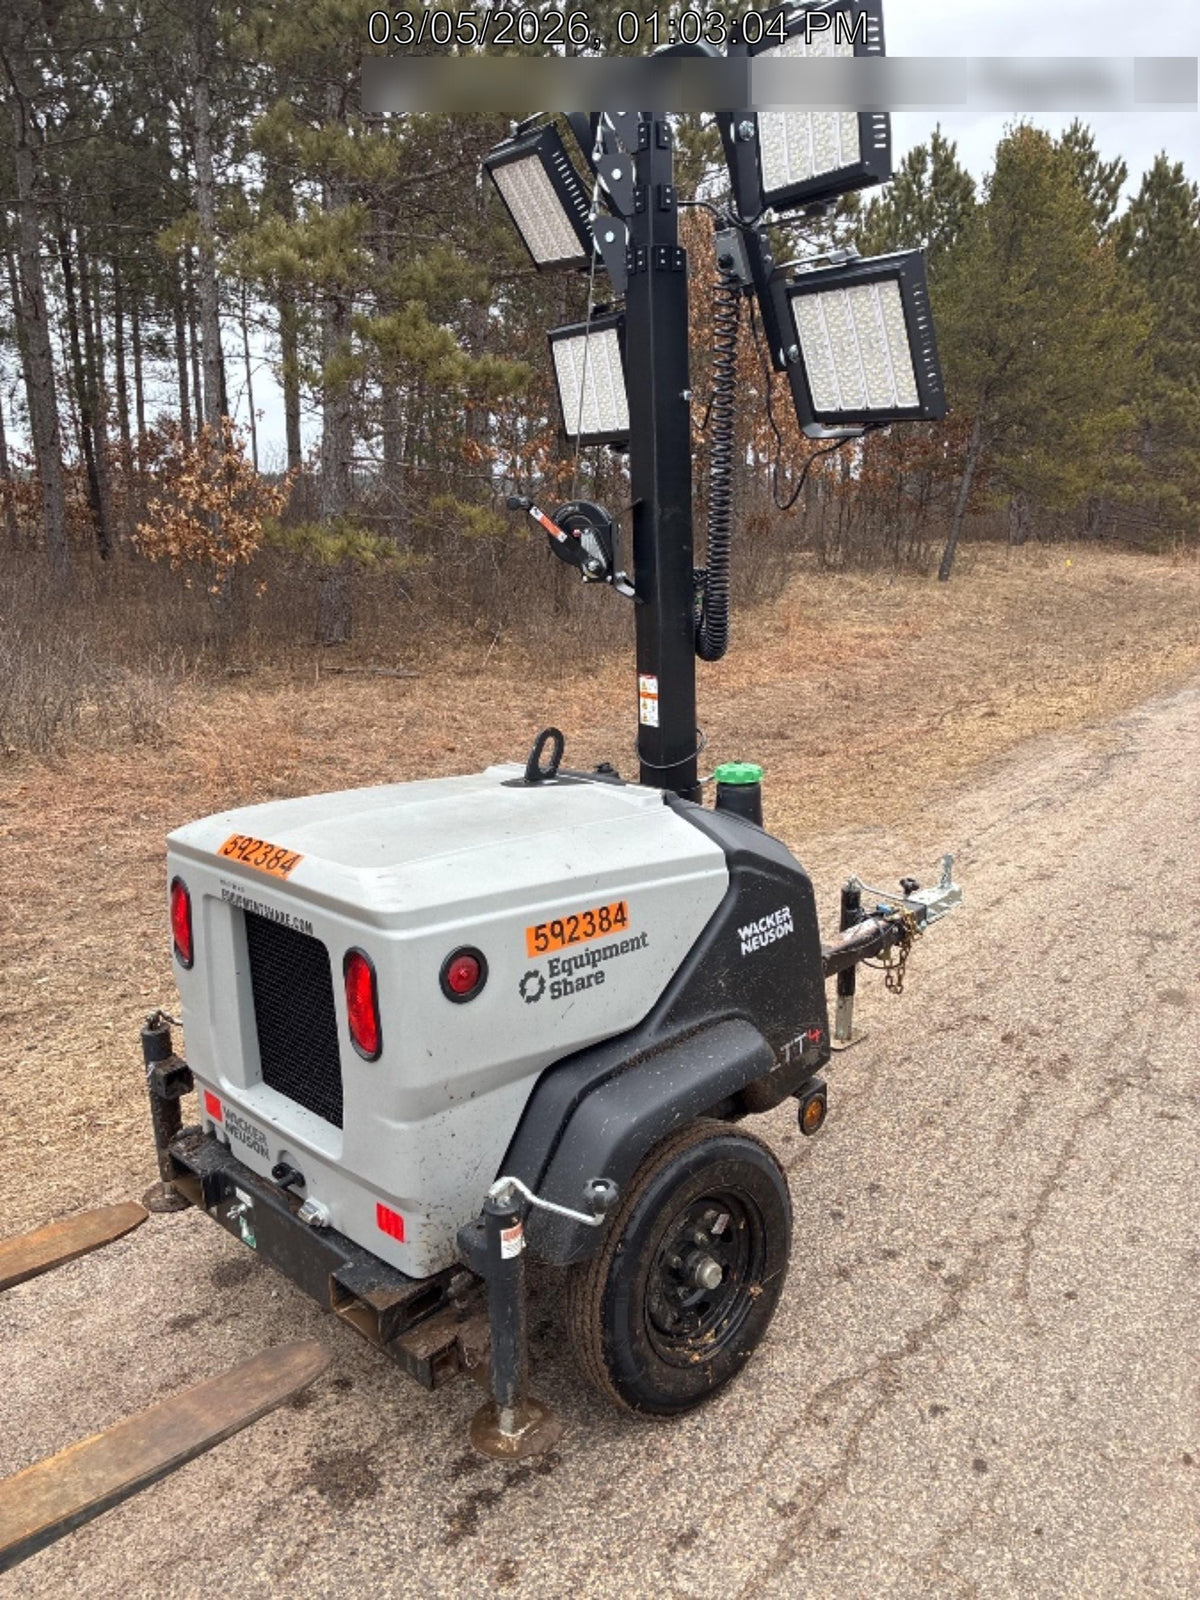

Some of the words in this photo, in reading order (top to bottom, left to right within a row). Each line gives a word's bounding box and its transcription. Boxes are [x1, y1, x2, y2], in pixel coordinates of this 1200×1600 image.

[222, 835, 300, 875] 592384
[534, 901, 627, 952] 592384
[737, 905, 791, 942] WACKER
[740, 919, 794, 956] NEUSON
[547, 931, 649, 979] Equipment
[549, 970, 605, 1000] Share
[223, 1106, 268, 1146] WACKER
[225, 1119, 271, 1161] NEUSON
